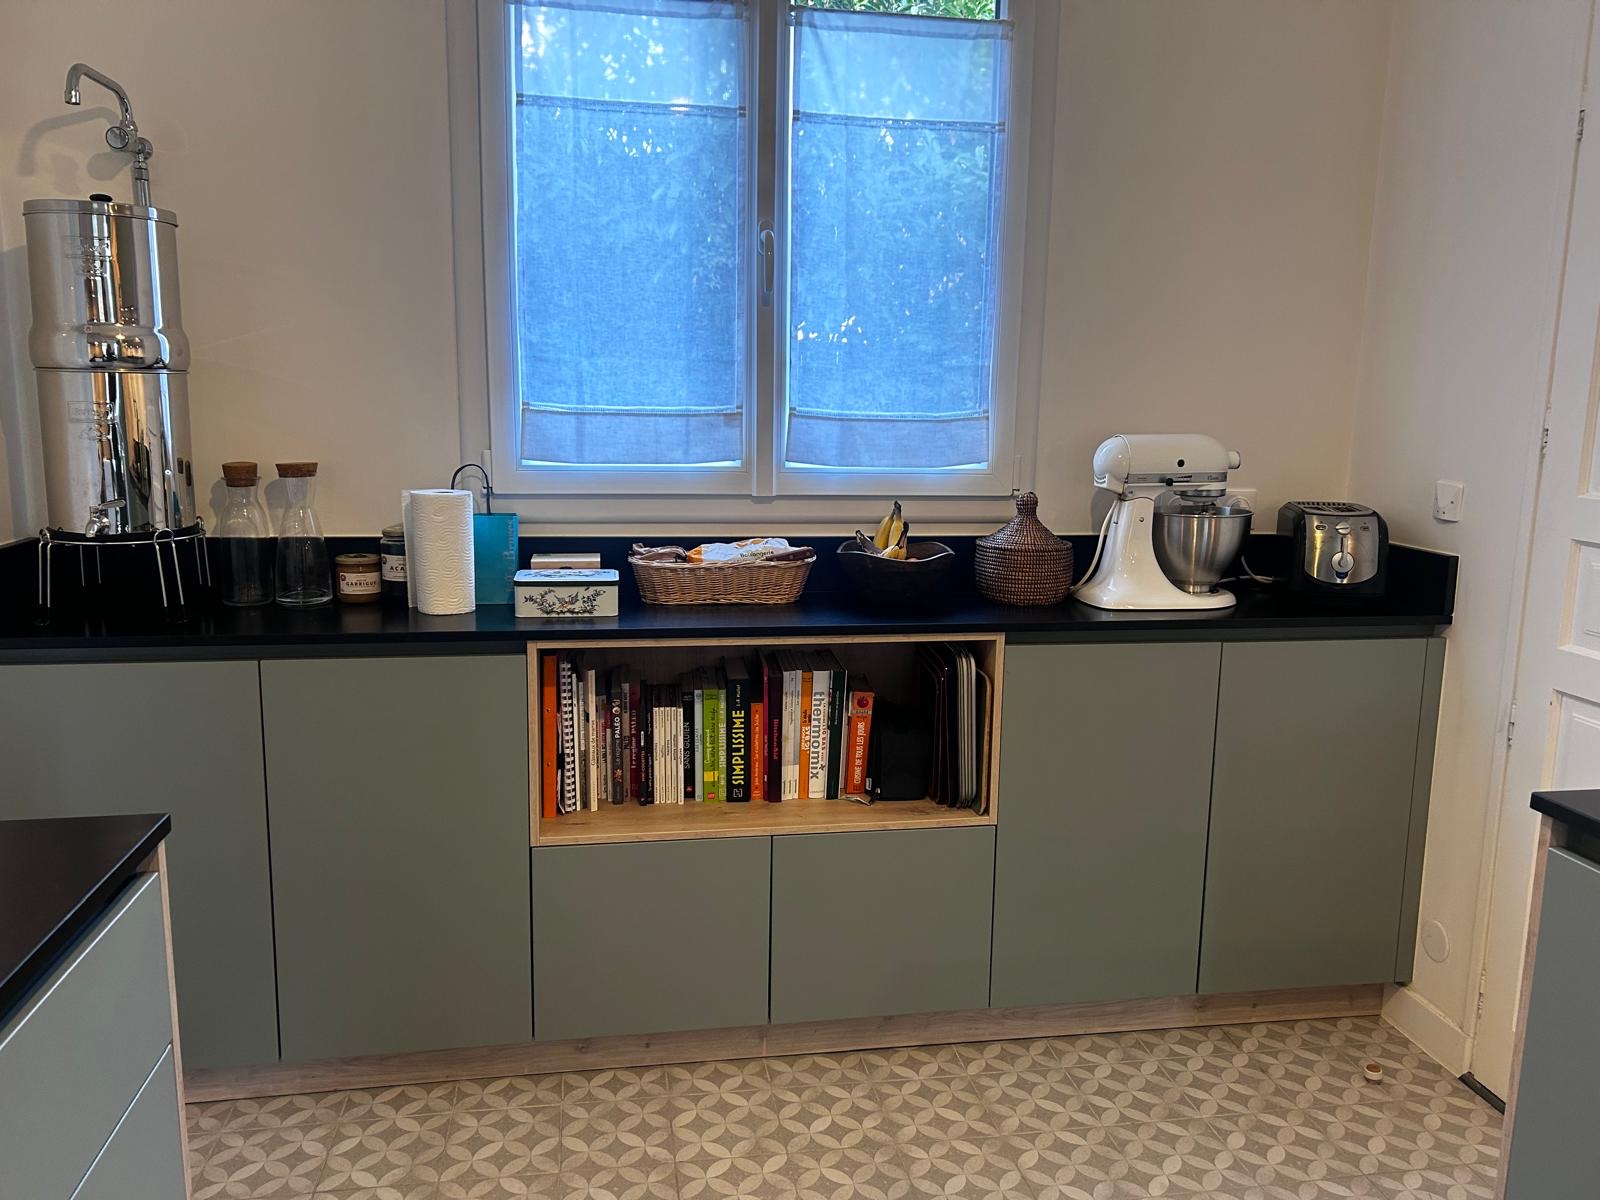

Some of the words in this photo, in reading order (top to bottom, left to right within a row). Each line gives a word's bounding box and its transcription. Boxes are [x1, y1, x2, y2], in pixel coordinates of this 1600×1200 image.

[811, 691, 825, 779] thermomix
[856, 736, 864, 745] LES
[732, 710, 745, 785] SIMPLISSIME
[855, 745, 863, 758] TOUS
[855, 758, 863, 766] DE
[853, 767, 862, 784] CUISINE
